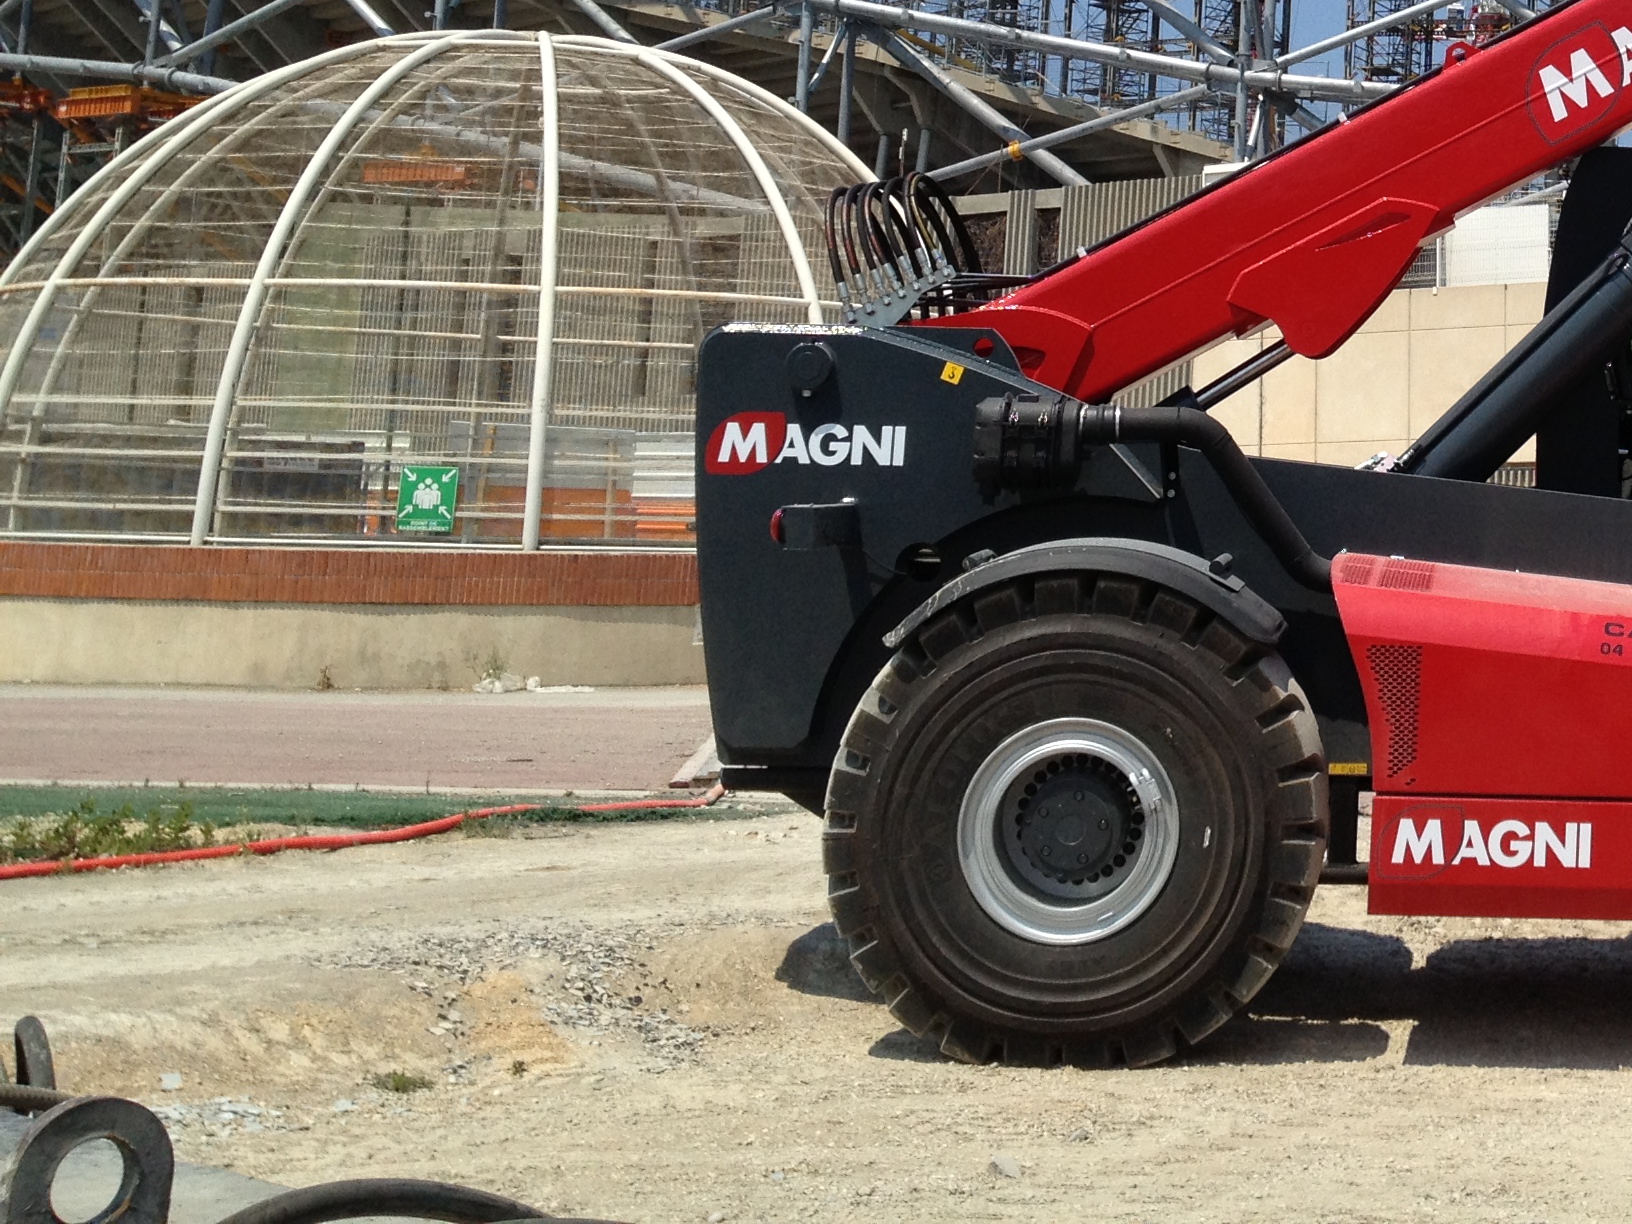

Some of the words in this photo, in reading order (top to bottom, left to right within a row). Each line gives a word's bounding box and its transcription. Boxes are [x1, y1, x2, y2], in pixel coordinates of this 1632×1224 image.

[717, 422, 907, 466] MAGNI
[1600, 642, 1623, 656] 04
[1391, 818, 1592, 868] MAGNI
